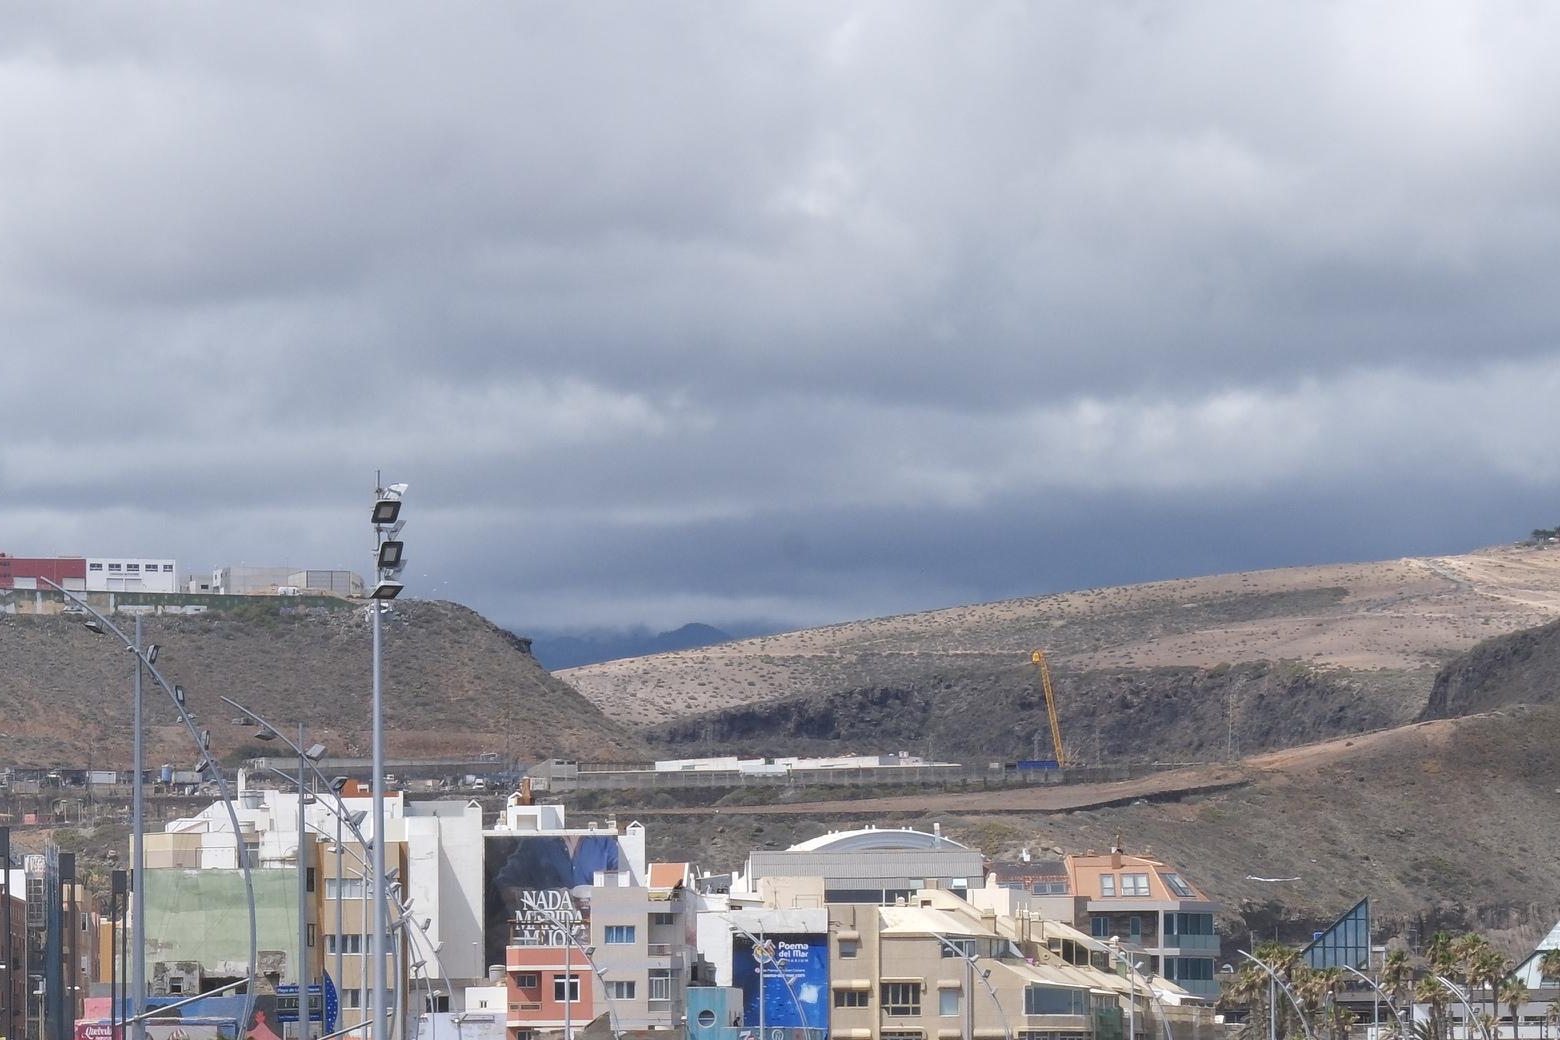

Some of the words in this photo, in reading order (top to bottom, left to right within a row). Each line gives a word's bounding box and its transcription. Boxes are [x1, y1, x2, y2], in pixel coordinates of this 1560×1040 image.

[522, 890, 574, 911] NADA
[778, 941, 809, 950] Poema
[793, 950, 809, 958] Mar
